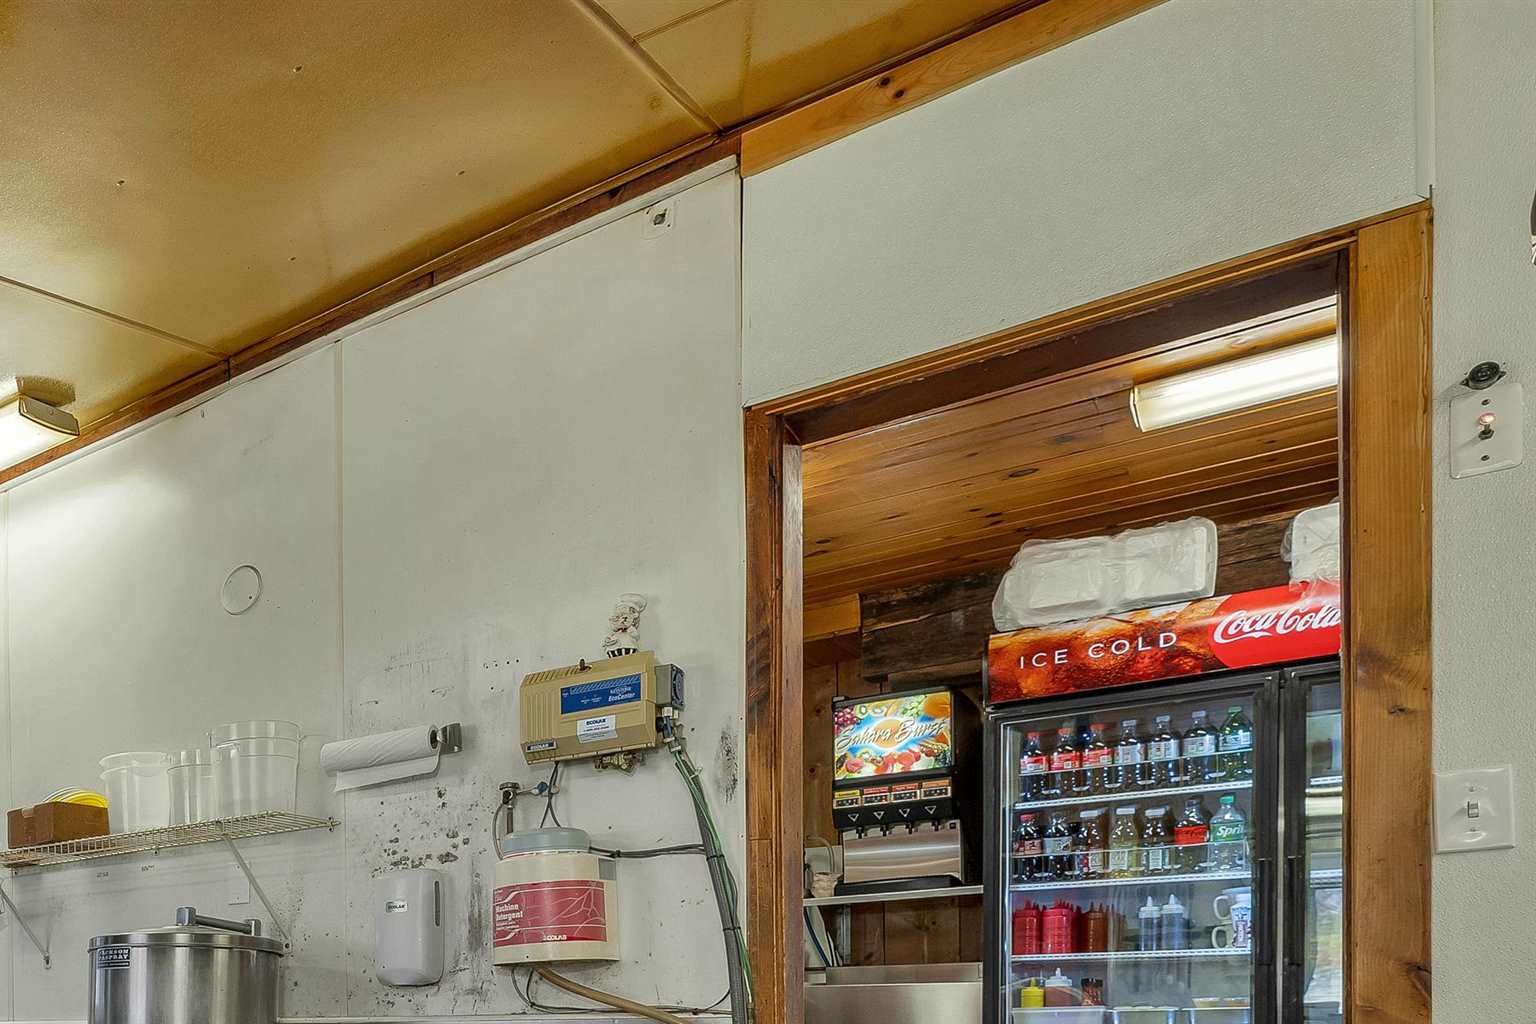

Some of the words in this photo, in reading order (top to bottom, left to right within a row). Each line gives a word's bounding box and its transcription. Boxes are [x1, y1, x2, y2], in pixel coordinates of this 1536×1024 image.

[1020, 649, 1069, 669] ICE
[1087, 632, 1178, 658] COLD
[836, 726, 895, 750] Sahara
